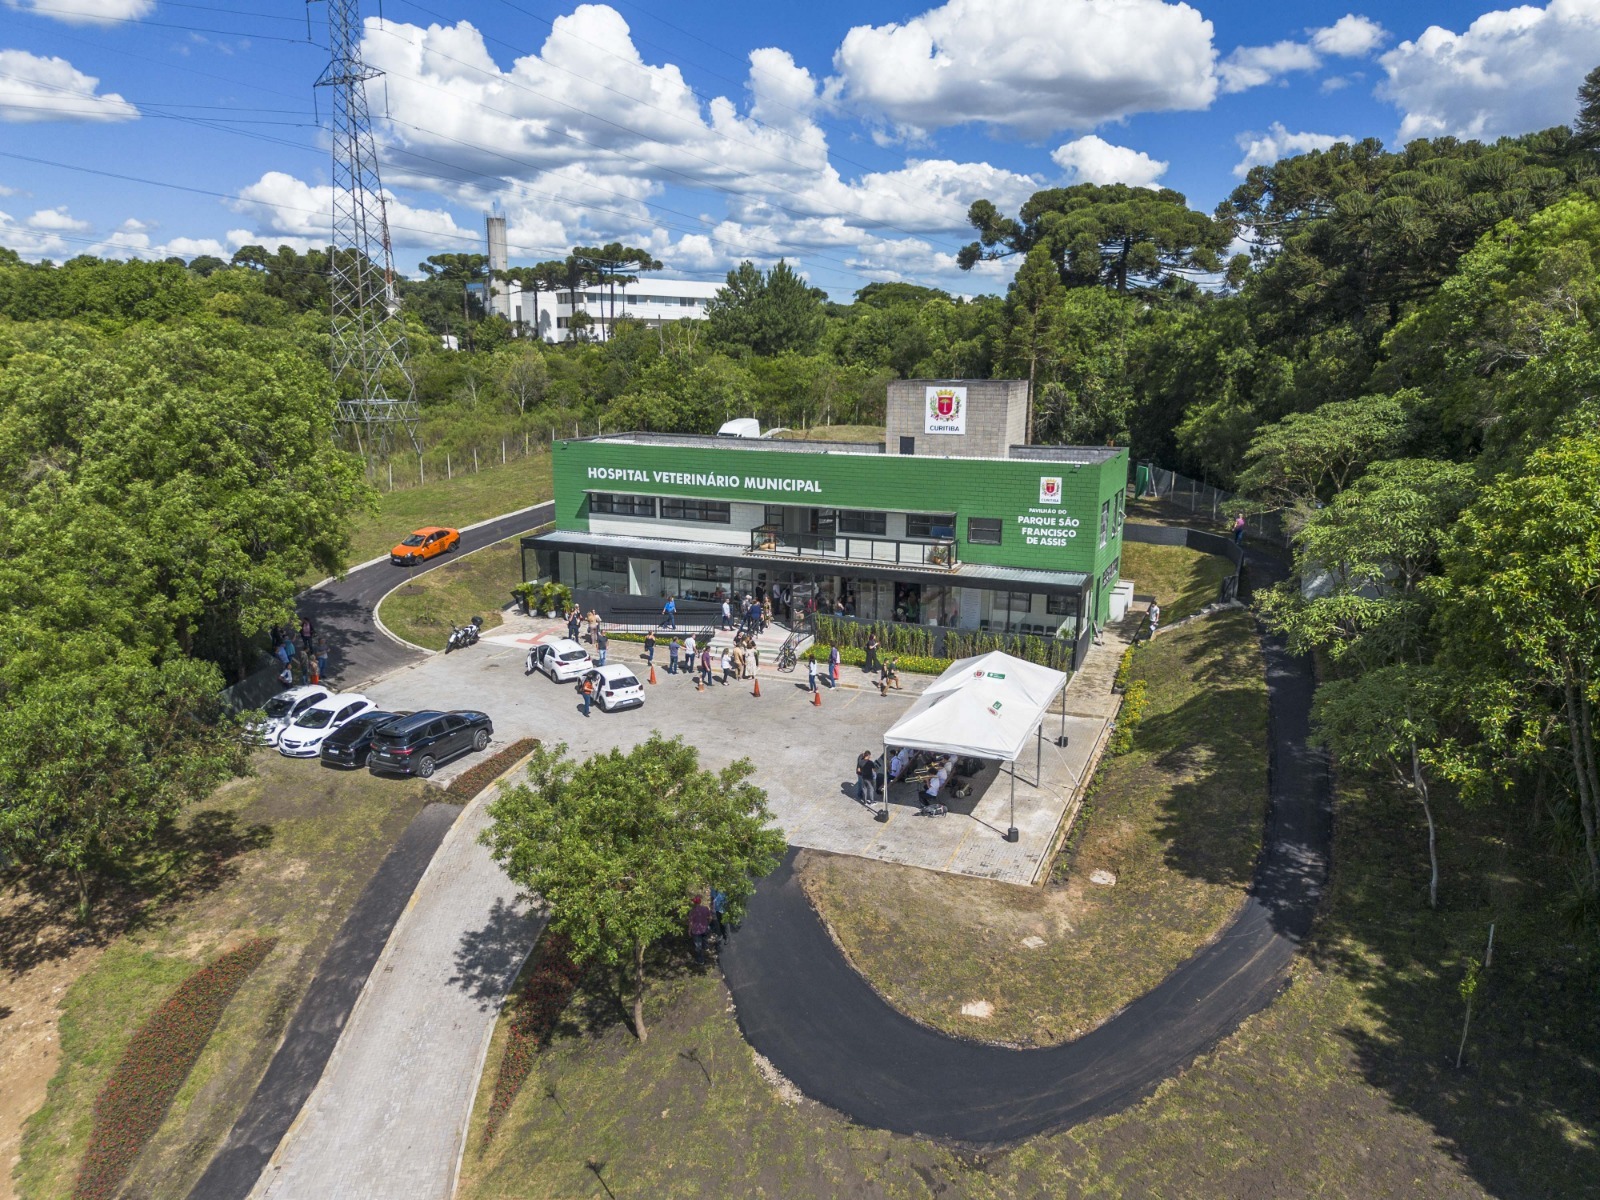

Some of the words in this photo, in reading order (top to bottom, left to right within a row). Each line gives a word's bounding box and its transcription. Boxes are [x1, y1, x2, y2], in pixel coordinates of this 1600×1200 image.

[587, 467, 650, 483] HOSPITAL
[652, 471, 740, 488] VETERINÁRIO
[744, 477, 822, 493] MUNICIPAL
[1017, 516, 1056, 526] PARQUE
[1058, 517, 1080, 527] SÃO
[1022, 528, 1076, 538] FRANCISCO
[1040, 538, 1066, 546] ASSIS
